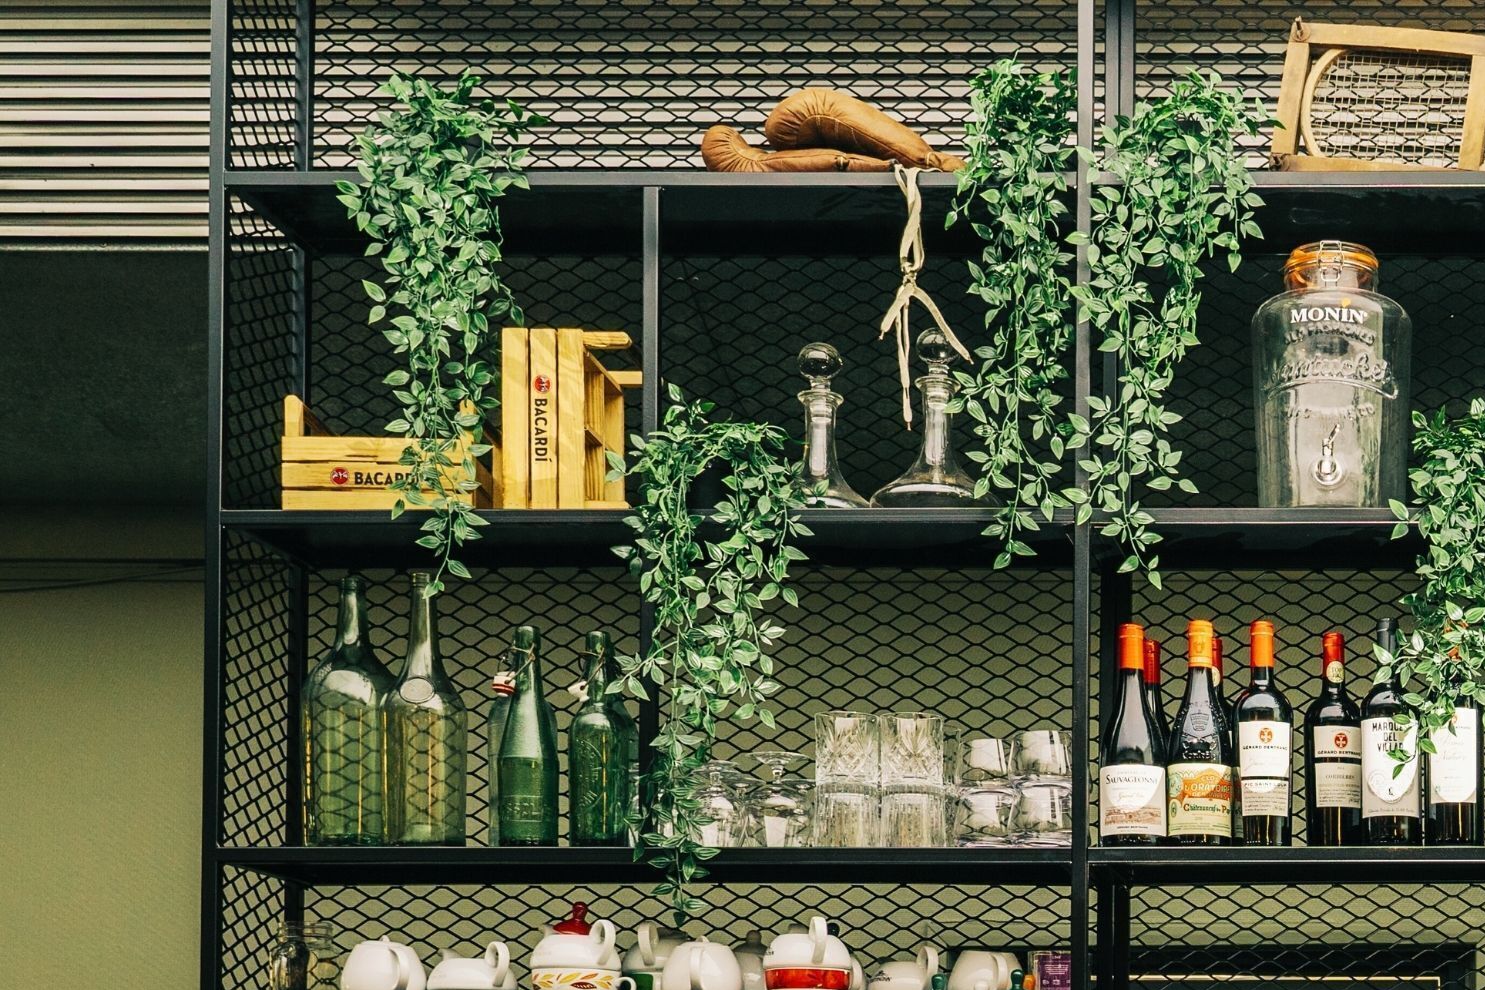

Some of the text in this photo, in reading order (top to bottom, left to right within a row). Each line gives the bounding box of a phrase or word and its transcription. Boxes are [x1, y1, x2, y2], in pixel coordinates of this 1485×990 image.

[1290, 306, 1368, 324] MONIN
[534, 398, 554, 463] BACARDÍ
[1383, 731, 1398, 742] DEL
